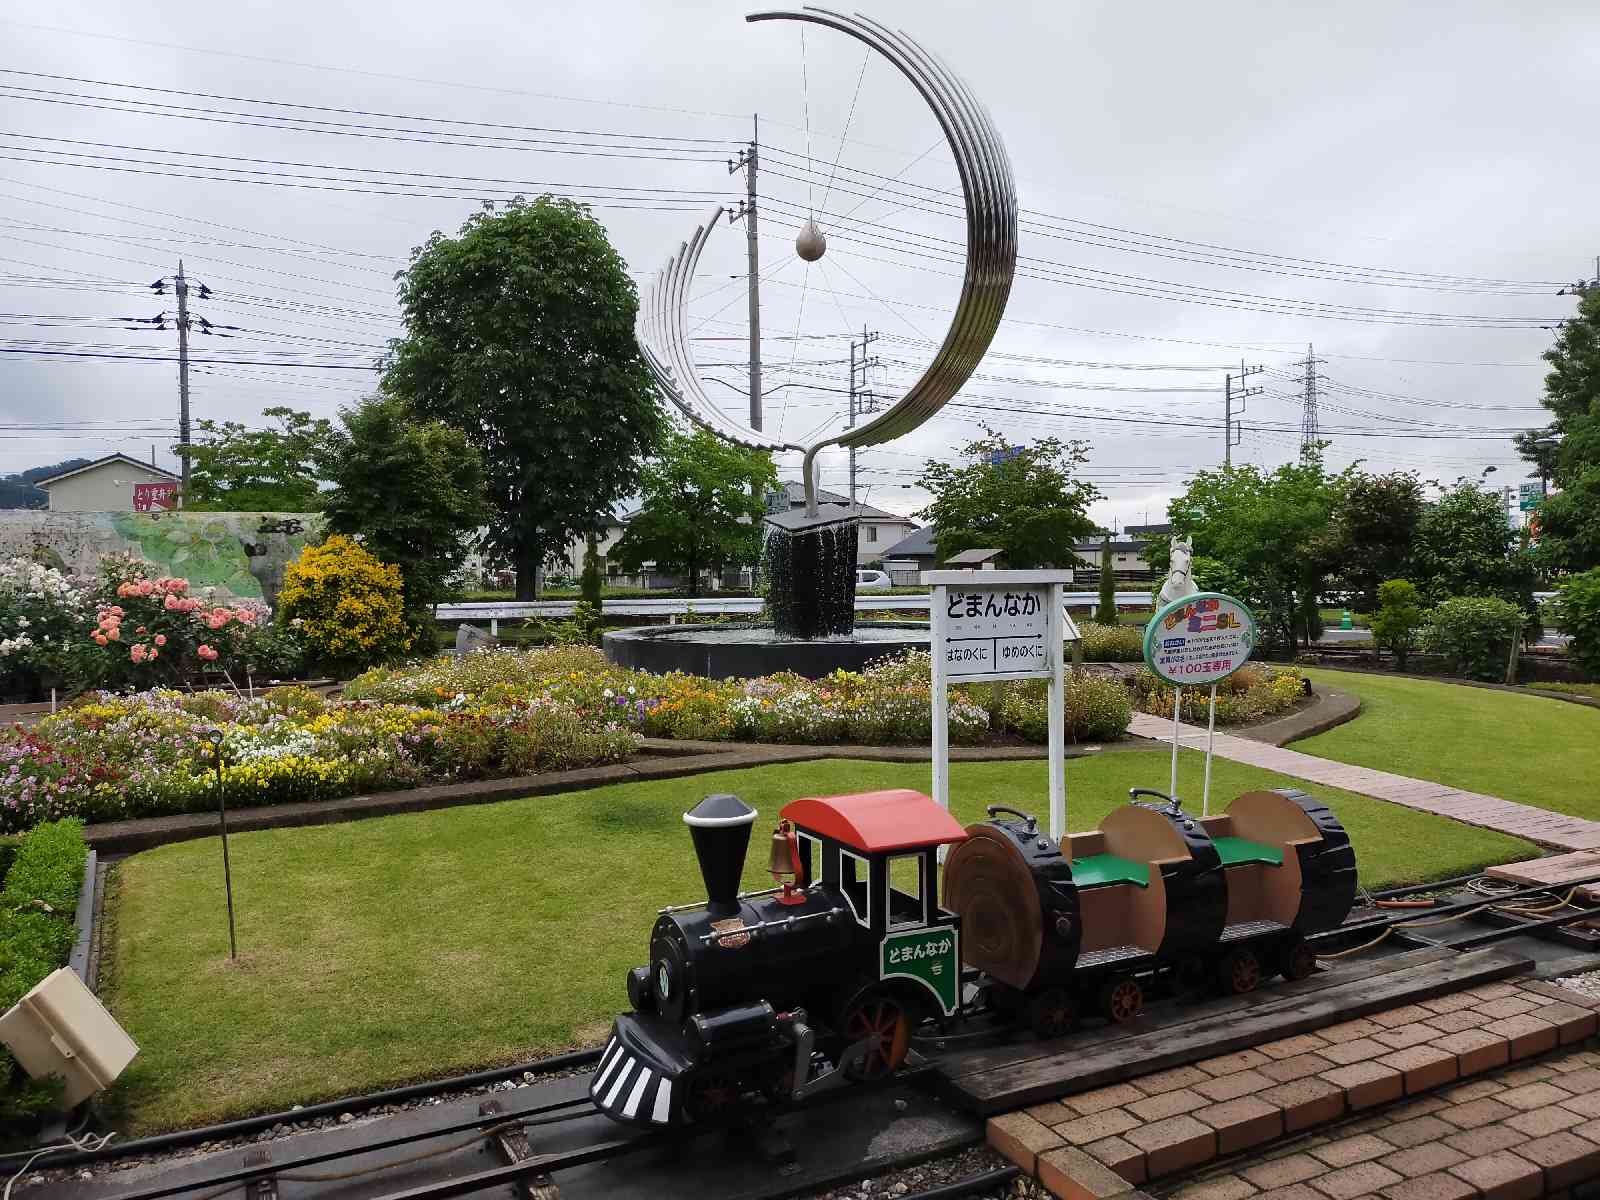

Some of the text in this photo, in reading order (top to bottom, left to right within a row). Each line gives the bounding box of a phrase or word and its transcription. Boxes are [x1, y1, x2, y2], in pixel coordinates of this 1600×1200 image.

[947, 592, 1041, 618] どまんなか
[1002, 645, 1043, 659] ゆめのくに
